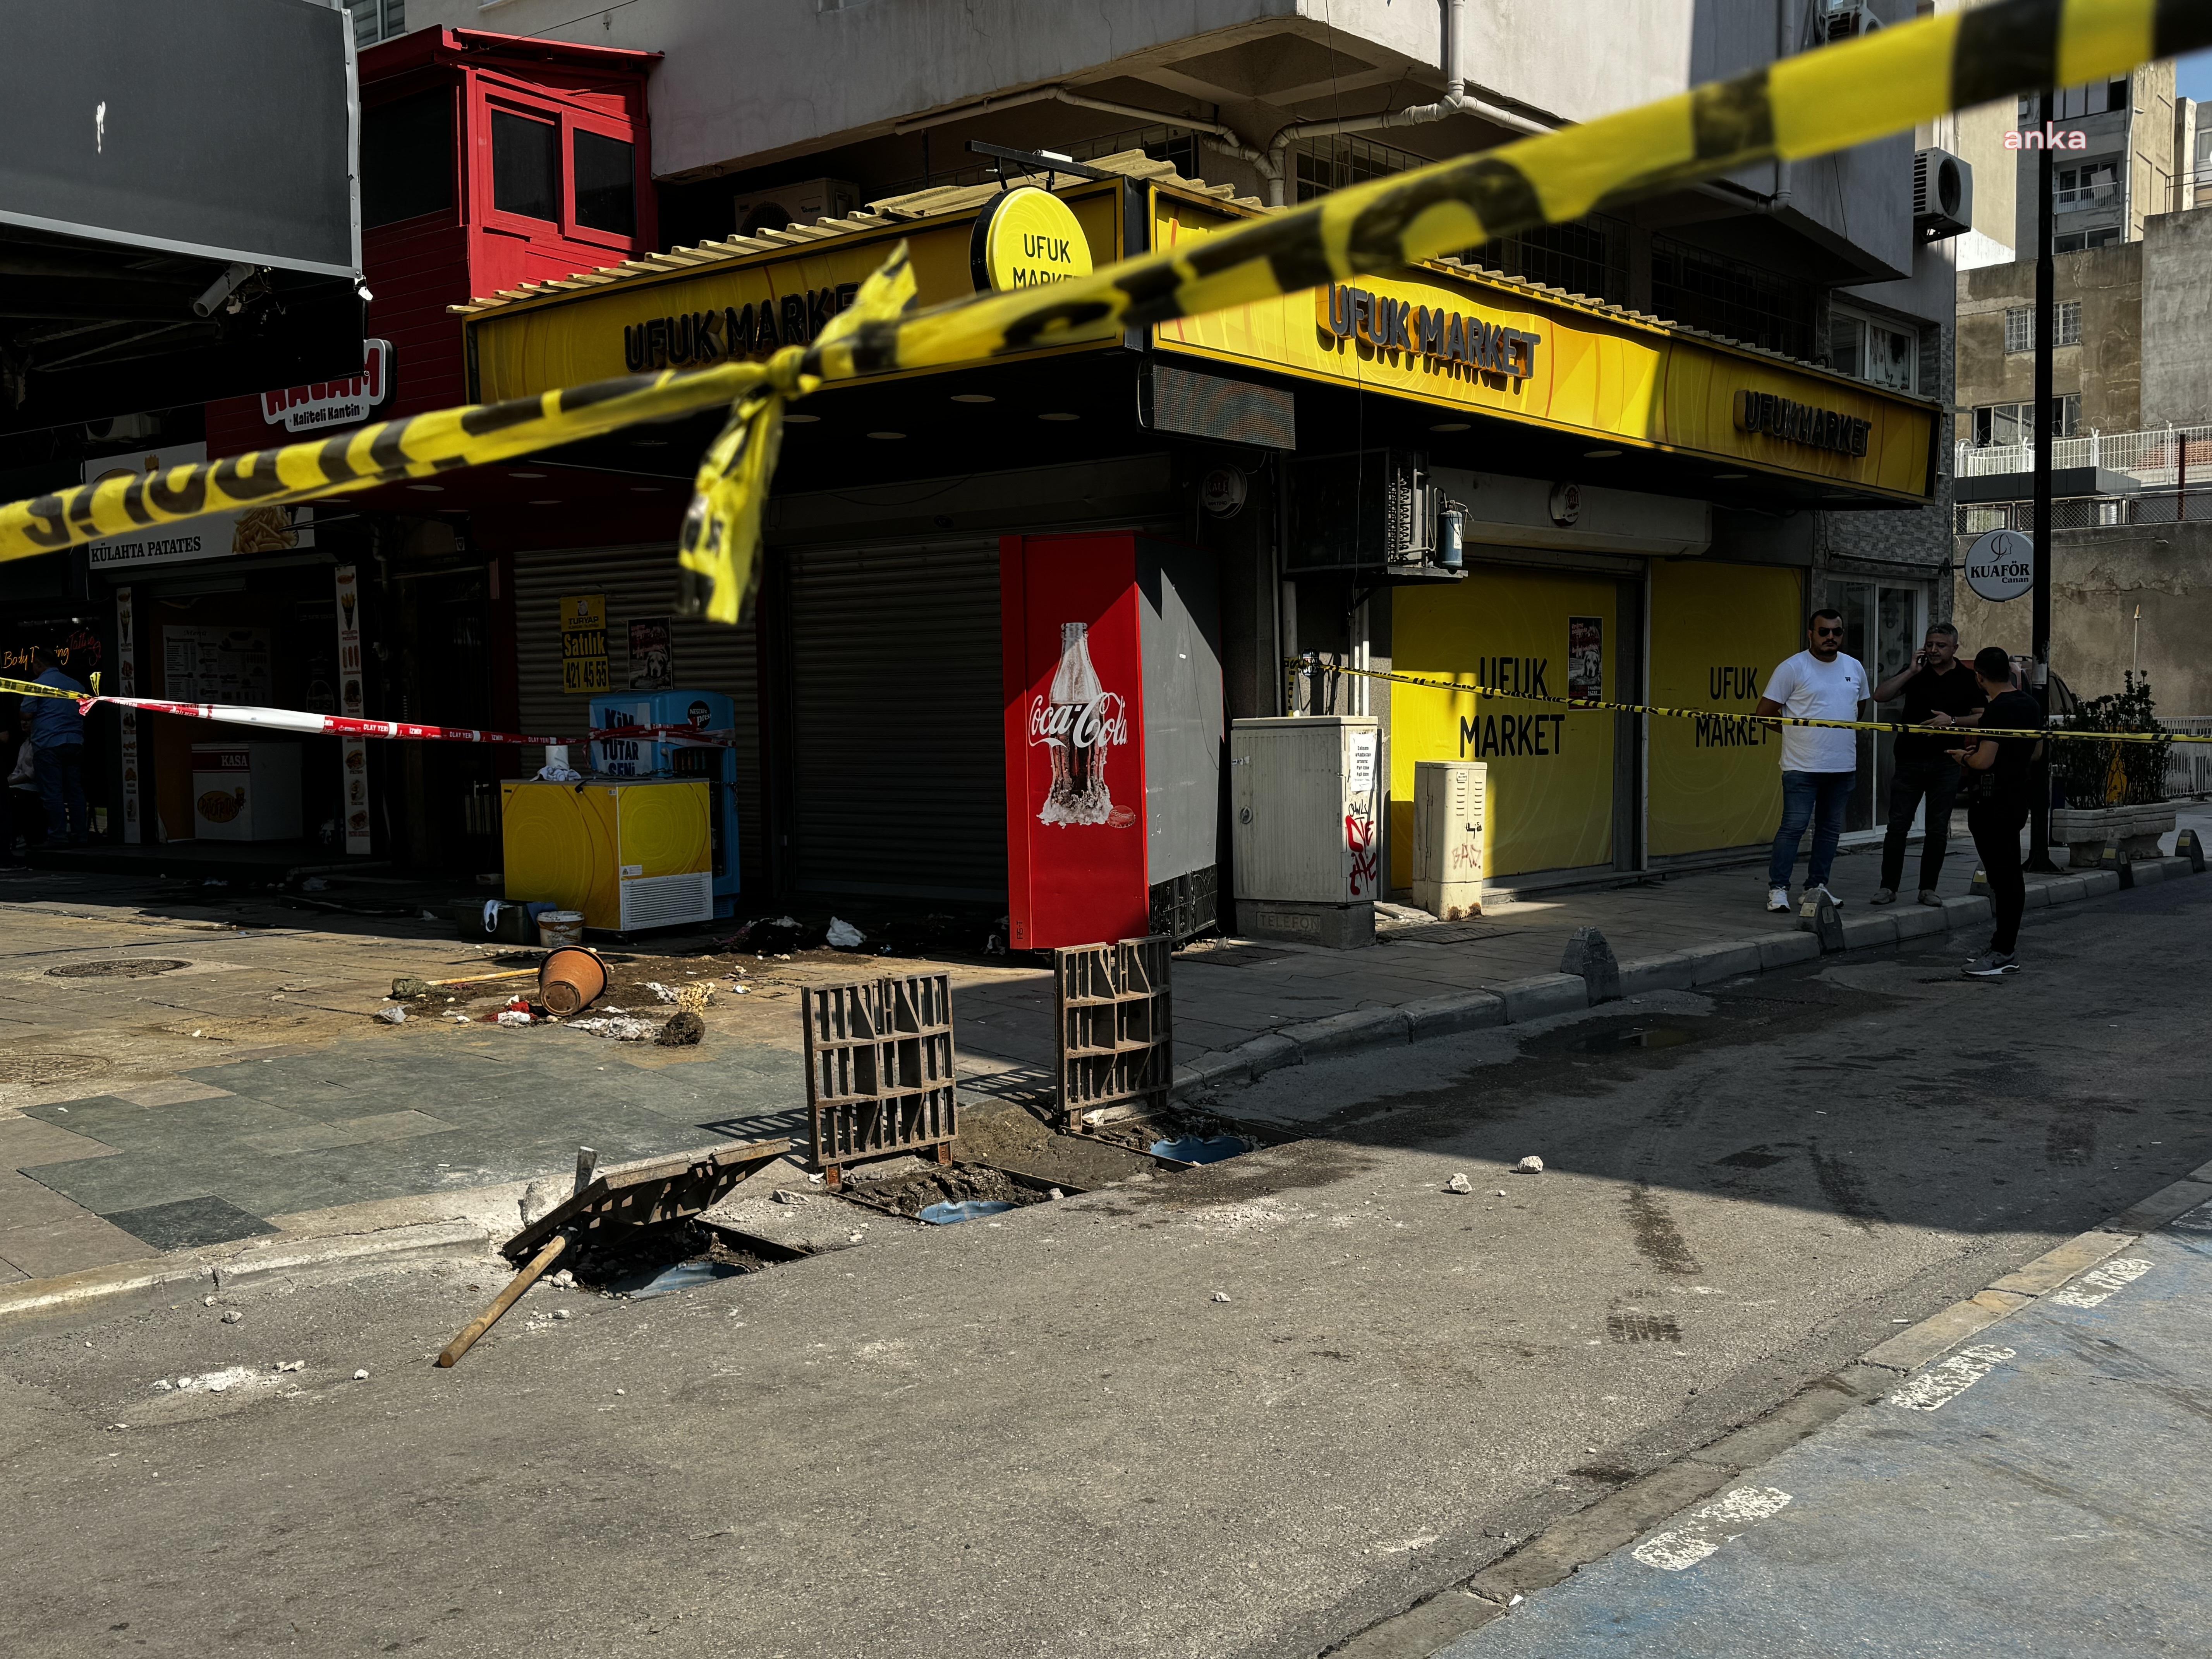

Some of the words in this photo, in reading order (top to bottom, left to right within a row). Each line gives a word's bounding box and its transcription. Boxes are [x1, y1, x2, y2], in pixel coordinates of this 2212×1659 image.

[1024, 233, 1071, 264] UFUK
[624, 309, 718, 372] UFUK
[1329, 282, 1411, 350] UFUK
[1419, 305, 1541, 379] MARKET
[293, 408, 326, 426] Kaliteli
[328, 404, 360, 420] Kantin
[1744, 390, 1796, 441] UFUK
[1797, 404, 1872, 457] MARKET
[1207, 480, 1228, 495] KALE
[91, 538, 145, 563] KÜLAHTA
[147, 536, 201, 555] PATATES
[1971, 560, 2030, 578] KUAFÖR
[568, 616, 599, 625] TURYAP
[564, 632, 606, 657] Satılık
[1, 648, 28, 671] Body
[566, 662, 580, 688] 421
[584, 661, 594, 687] 45
[596, 661, 606, 687] 55
[1479, 656, 1549, 700] UFUK
[1710, 666, 1758, 701] UFUK
[1028, 691, 1127, 748] Coca-Cola
[1695, 713, 1768, 748] MARKET
[600, 739, 639, 760] TUTAR
[1460, 714, 1565, 759] MARKET
[221, 755, 248, 767] KASA
[1261, 914, 1320, 930] TELEFON
